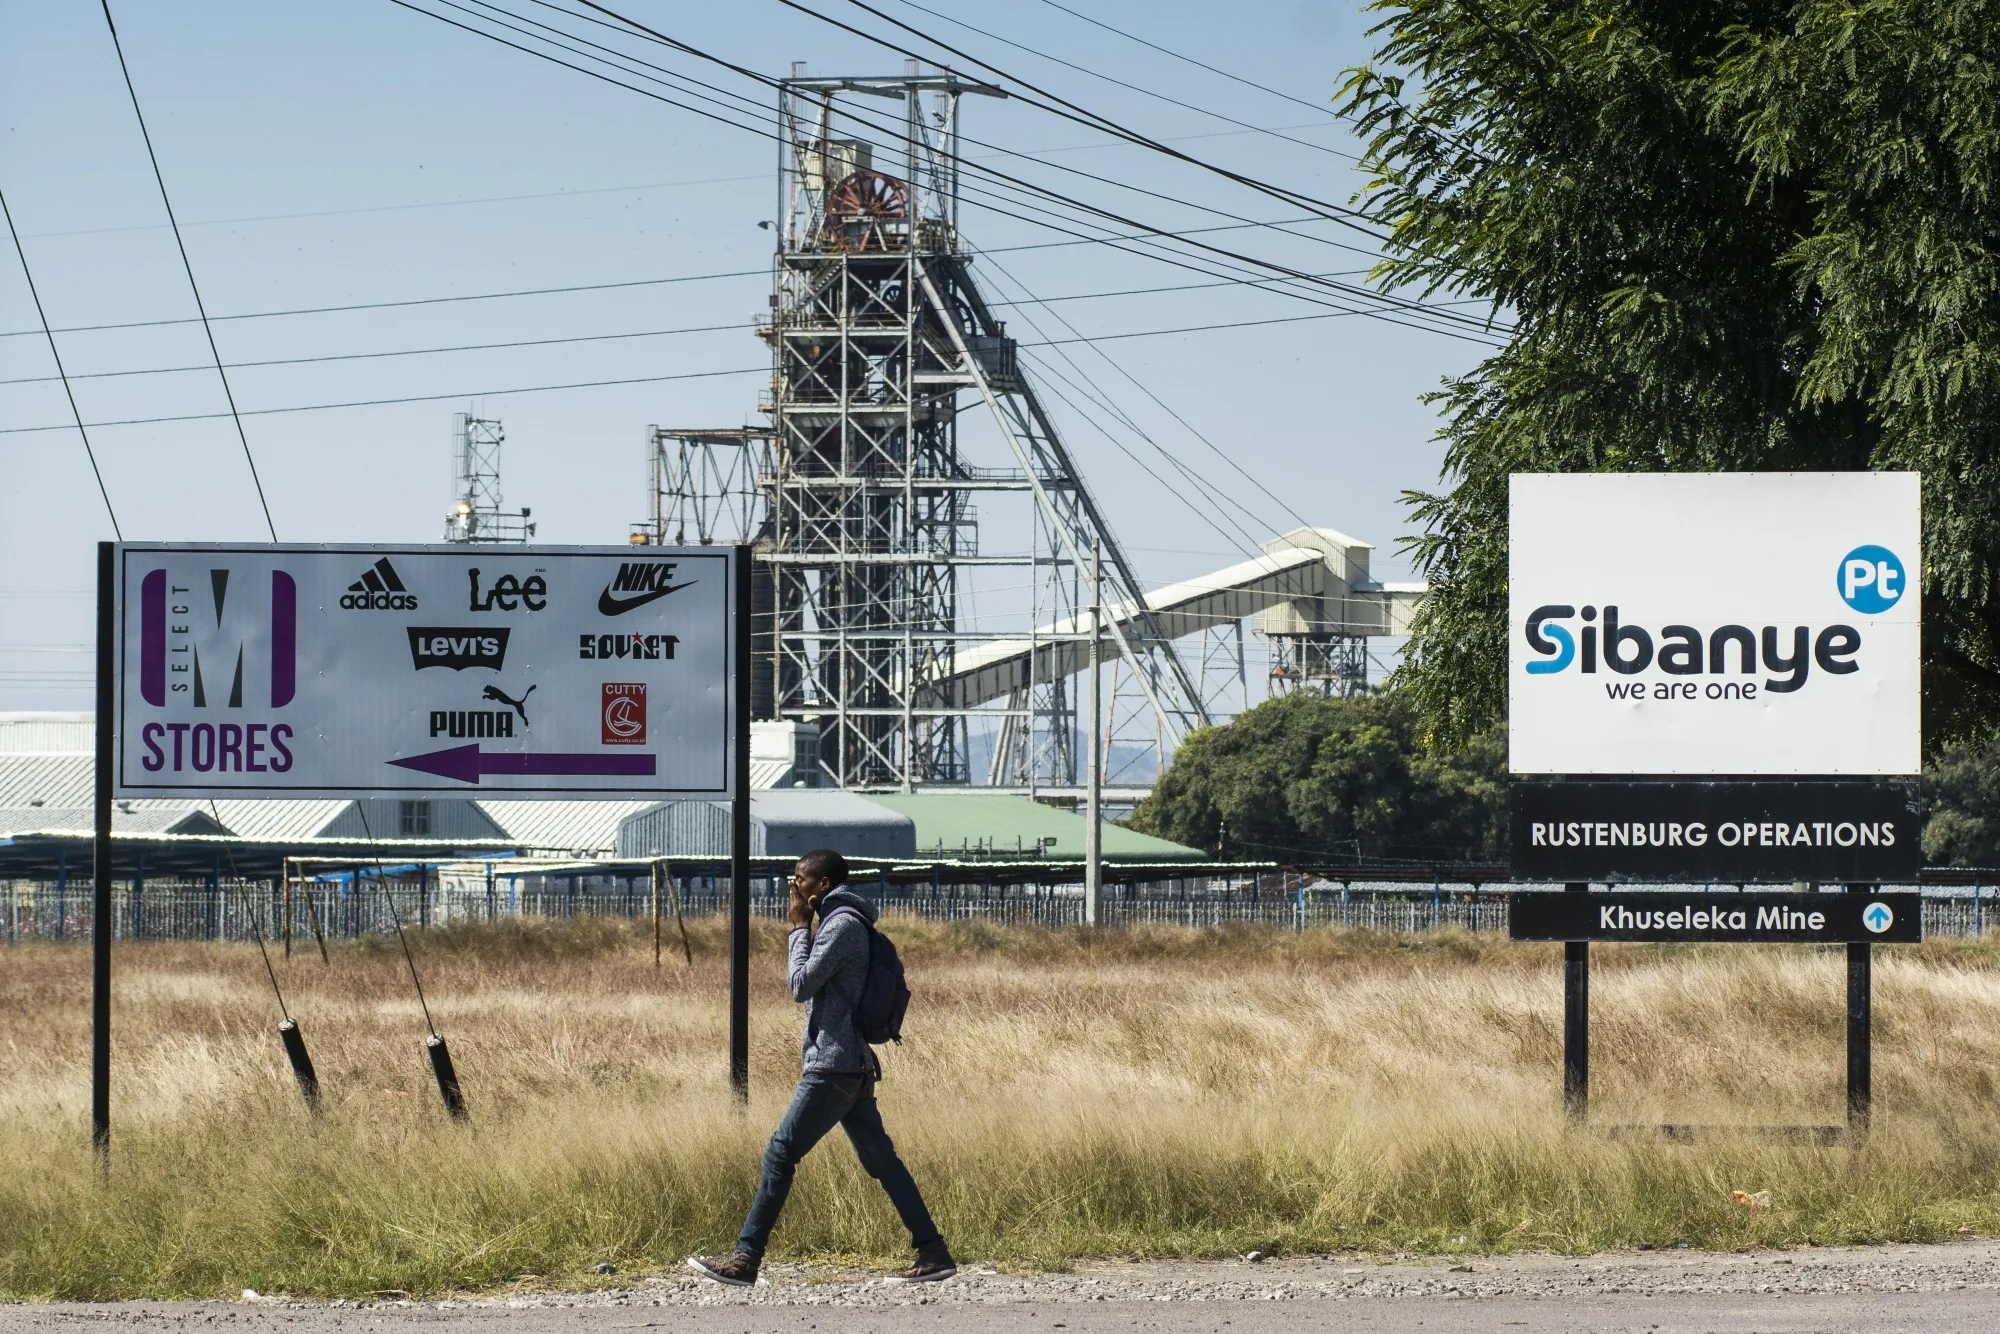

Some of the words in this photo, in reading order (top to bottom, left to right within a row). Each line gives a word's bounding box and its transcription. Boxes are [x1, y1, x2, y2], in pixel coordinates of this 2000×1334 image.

[468, 567, 547, 612] Lee
[611, 563, 678, 592] NIKE
[1844, 559, 1900, 600] Pt
[340, 590, 418, 611] adidas
[172, 585, 190, 692] SELECT
[1525, 605, 1861, 693] Sibanye
[605, 684, 646, 695] CUTTY
[1605, 683, 1645, 700] we
[1653, 683, 1697, 700] are
[1706, 683, 1757, 700] one
[430, 711, 513, 738] PUMA
[142, 722, 294, 773] STORES
[1531, 822, 1708, 847] RUSTENBURG
[1717, 822, 1895, 847] OPERATIONS
[1600, 905, 1746, 930] Khuseleka
[1755, 905, 1826, 930] Mine
